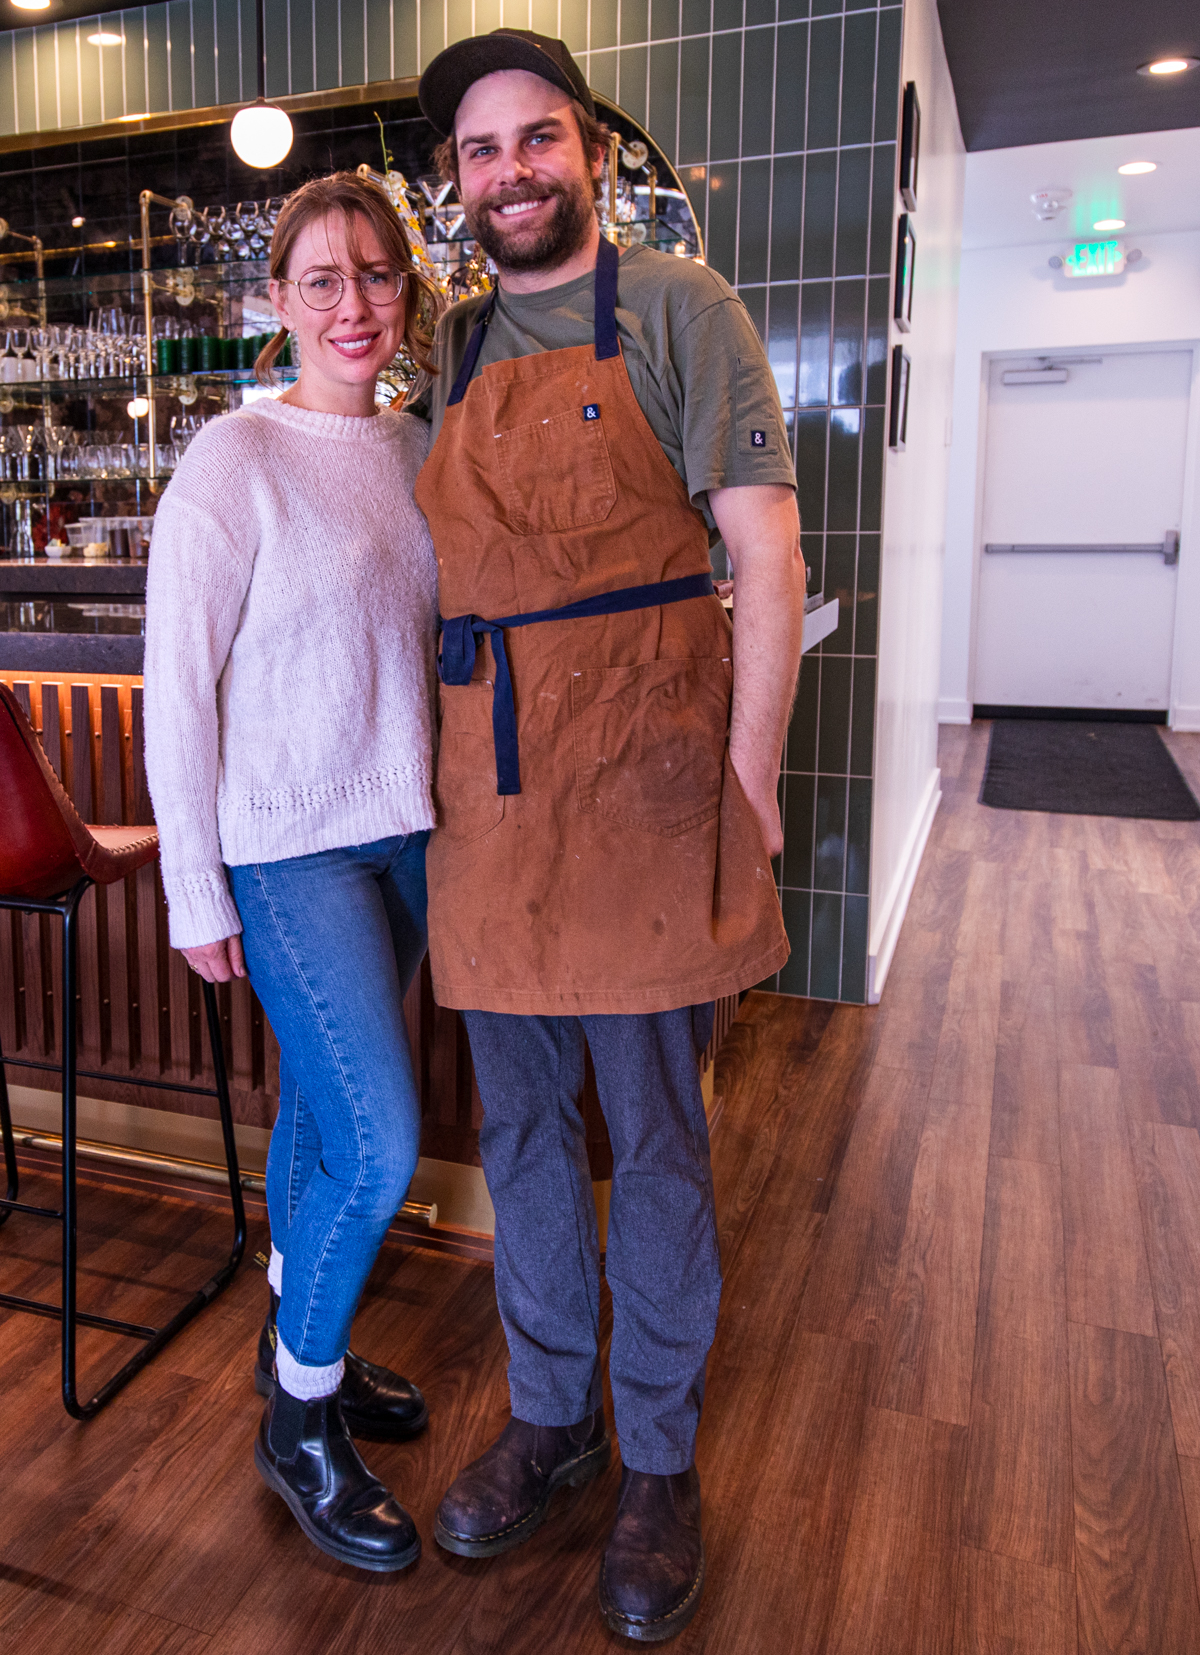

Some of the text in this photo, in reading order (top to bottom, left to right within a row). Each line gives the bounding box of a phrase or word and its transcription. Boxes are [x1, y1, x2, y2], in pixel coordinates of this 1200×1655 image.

[1072, 240, 1118, 277] EXIT
[586, 406, 597, 419] &
[754, 432, 763, 445] &
